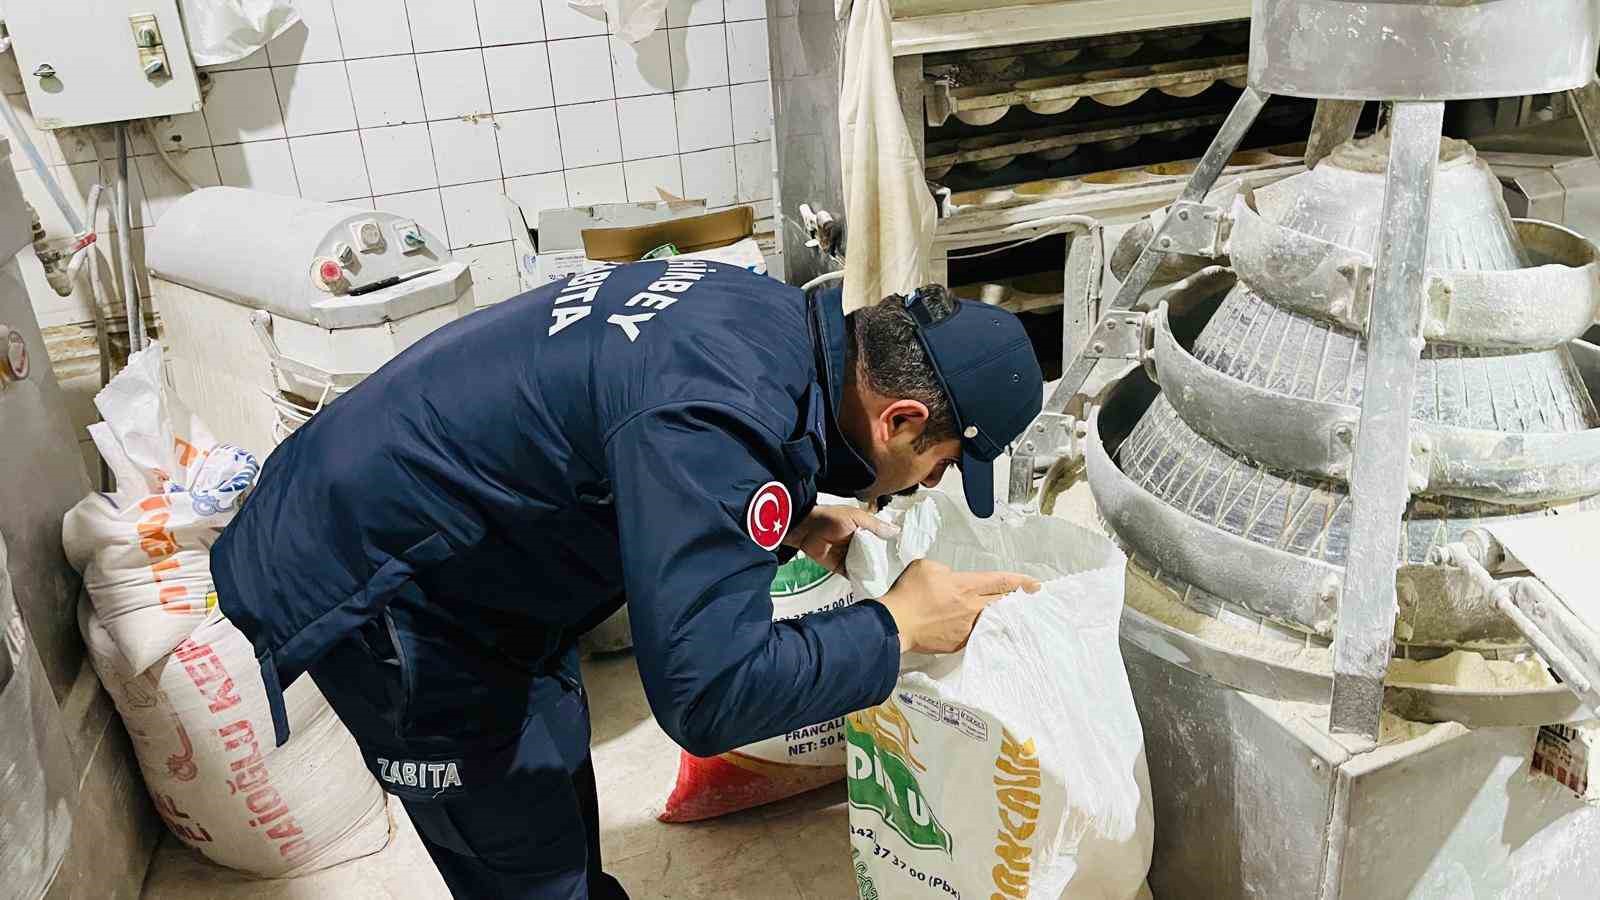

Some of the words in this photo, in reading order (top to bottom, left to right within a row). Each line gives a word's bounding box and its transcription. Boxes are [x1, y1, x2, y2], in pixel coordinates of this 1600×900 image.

[788, 741, 818, 757] NET:
[820, 736, 835, 748] 50
[377, 757, 463, 789] ZABITA
[909, 868, 926, 881] 00
